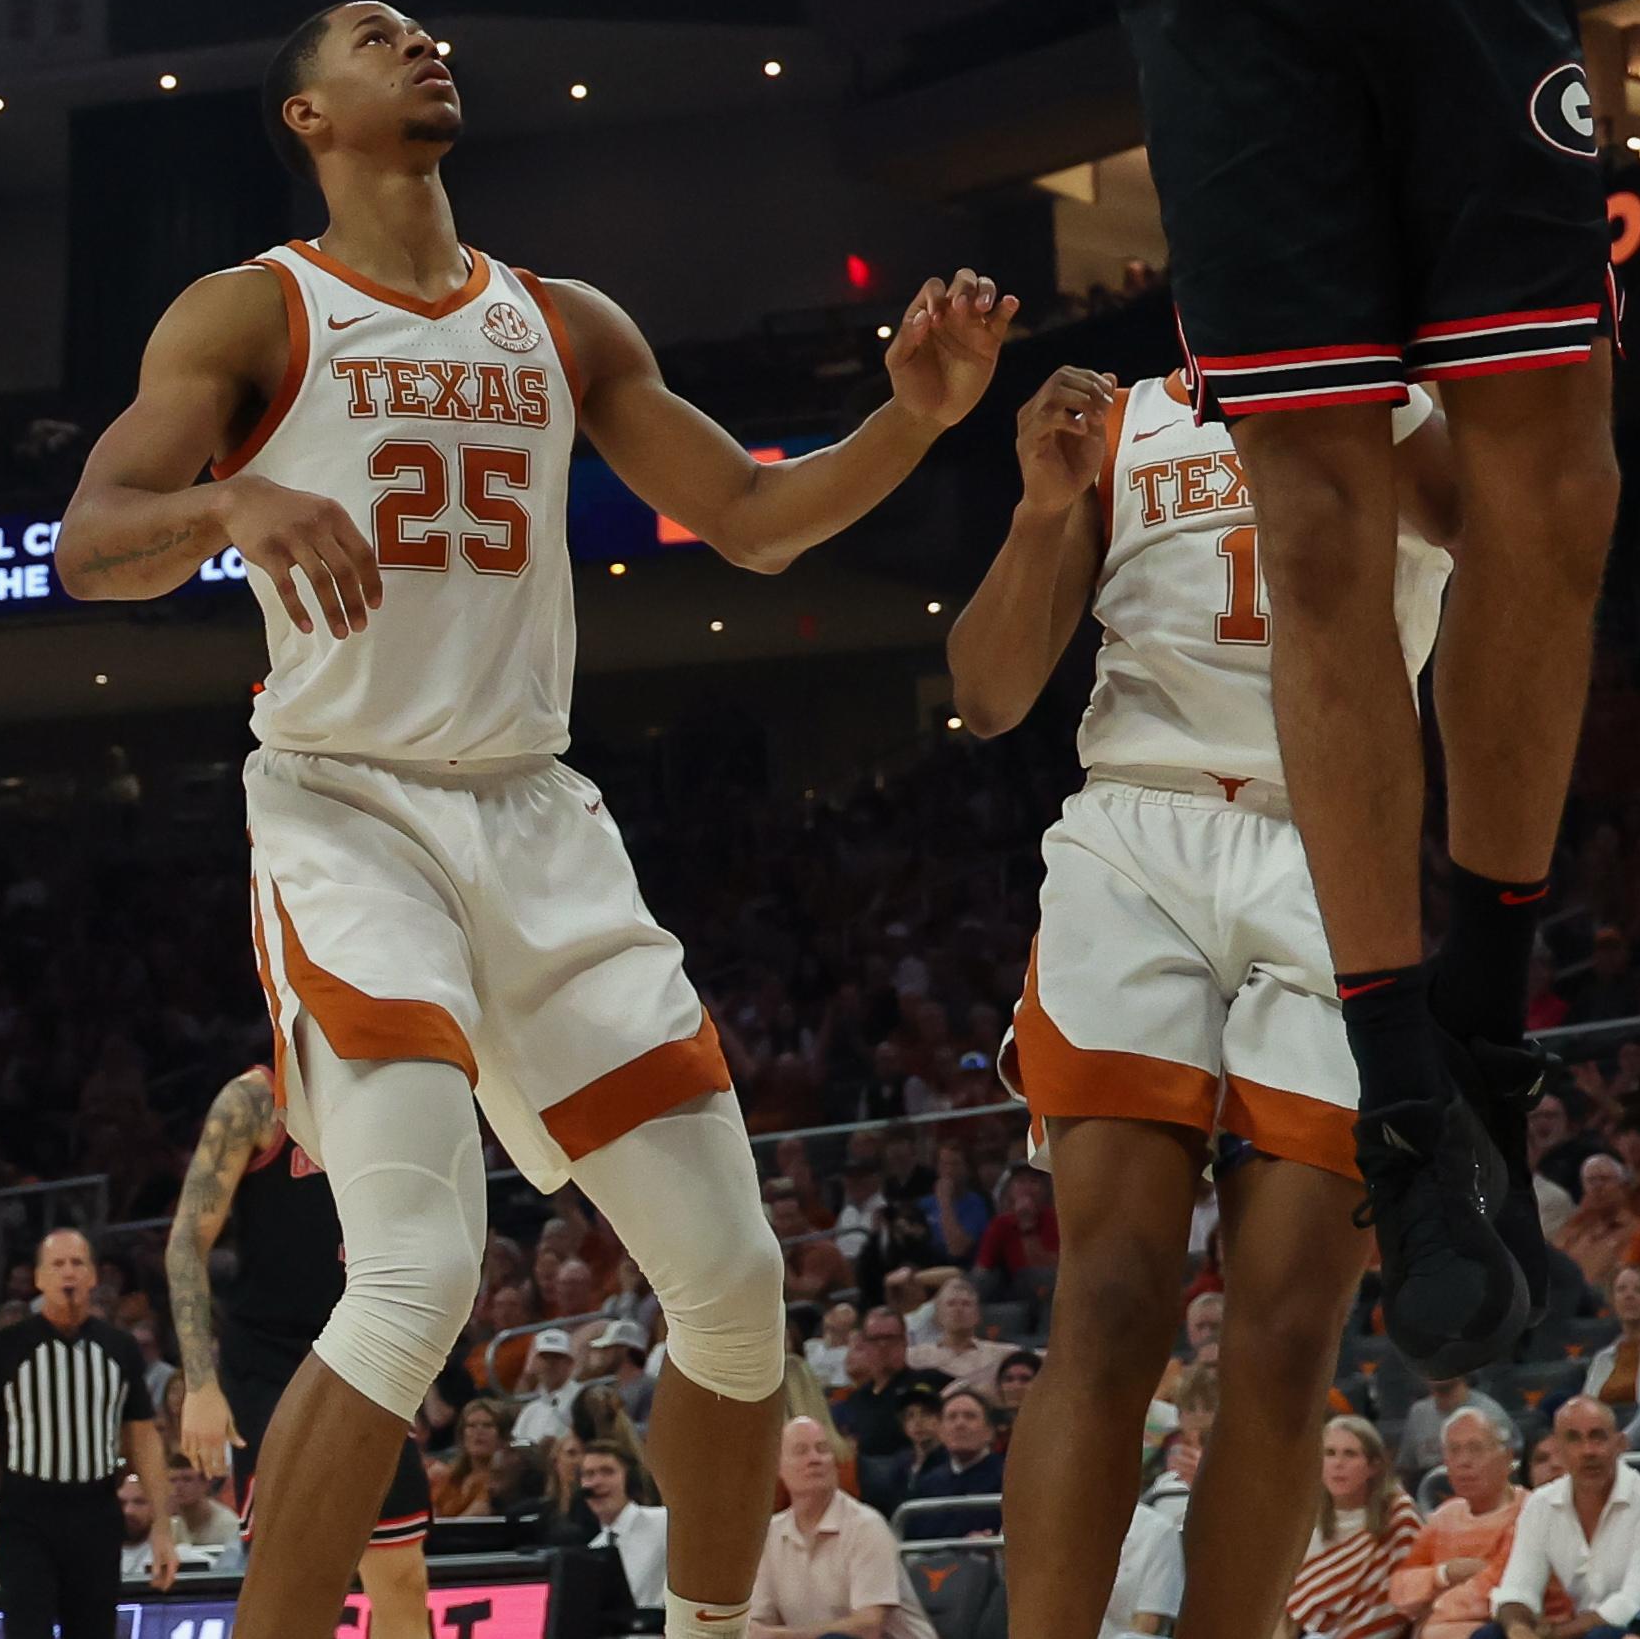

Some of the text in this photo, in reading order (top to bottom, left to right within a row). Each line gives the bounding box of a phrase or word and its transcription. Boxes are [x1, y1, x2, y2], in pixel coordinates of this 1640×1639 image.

[330, 356, 551, 430] TEXAS
[367, 438, 531, 578] 25
[1128, 449, 1256, 529] TEX
[1214, 522, 1272, 648] 1
